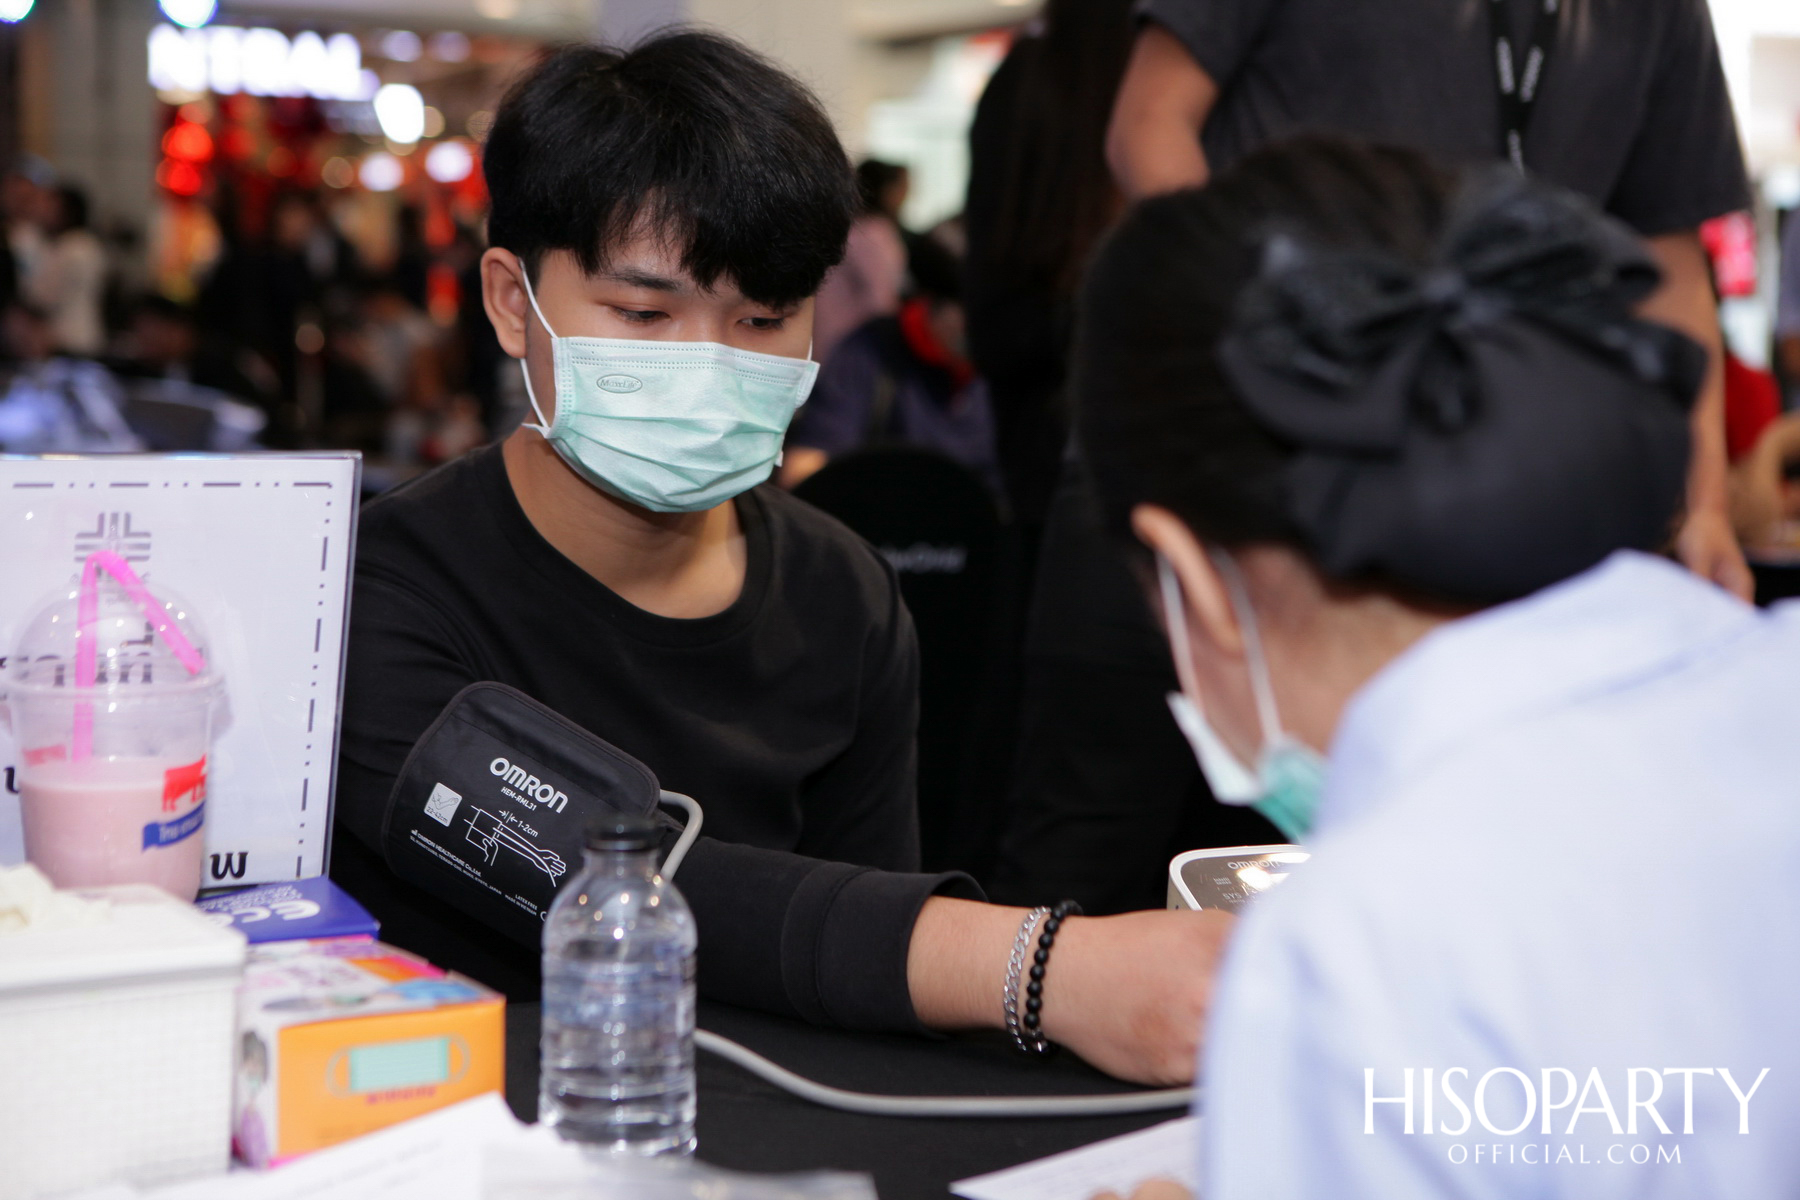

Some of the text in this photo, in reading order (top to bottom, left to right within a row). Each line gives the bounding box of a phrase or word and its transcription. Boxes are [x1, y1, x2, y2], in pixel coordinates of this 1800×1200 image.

[490, 757, 569, 814] OMRON
[501, 786, 537, 811] HEM-RML31
[518, 820, 539, 838] 1-2cm
